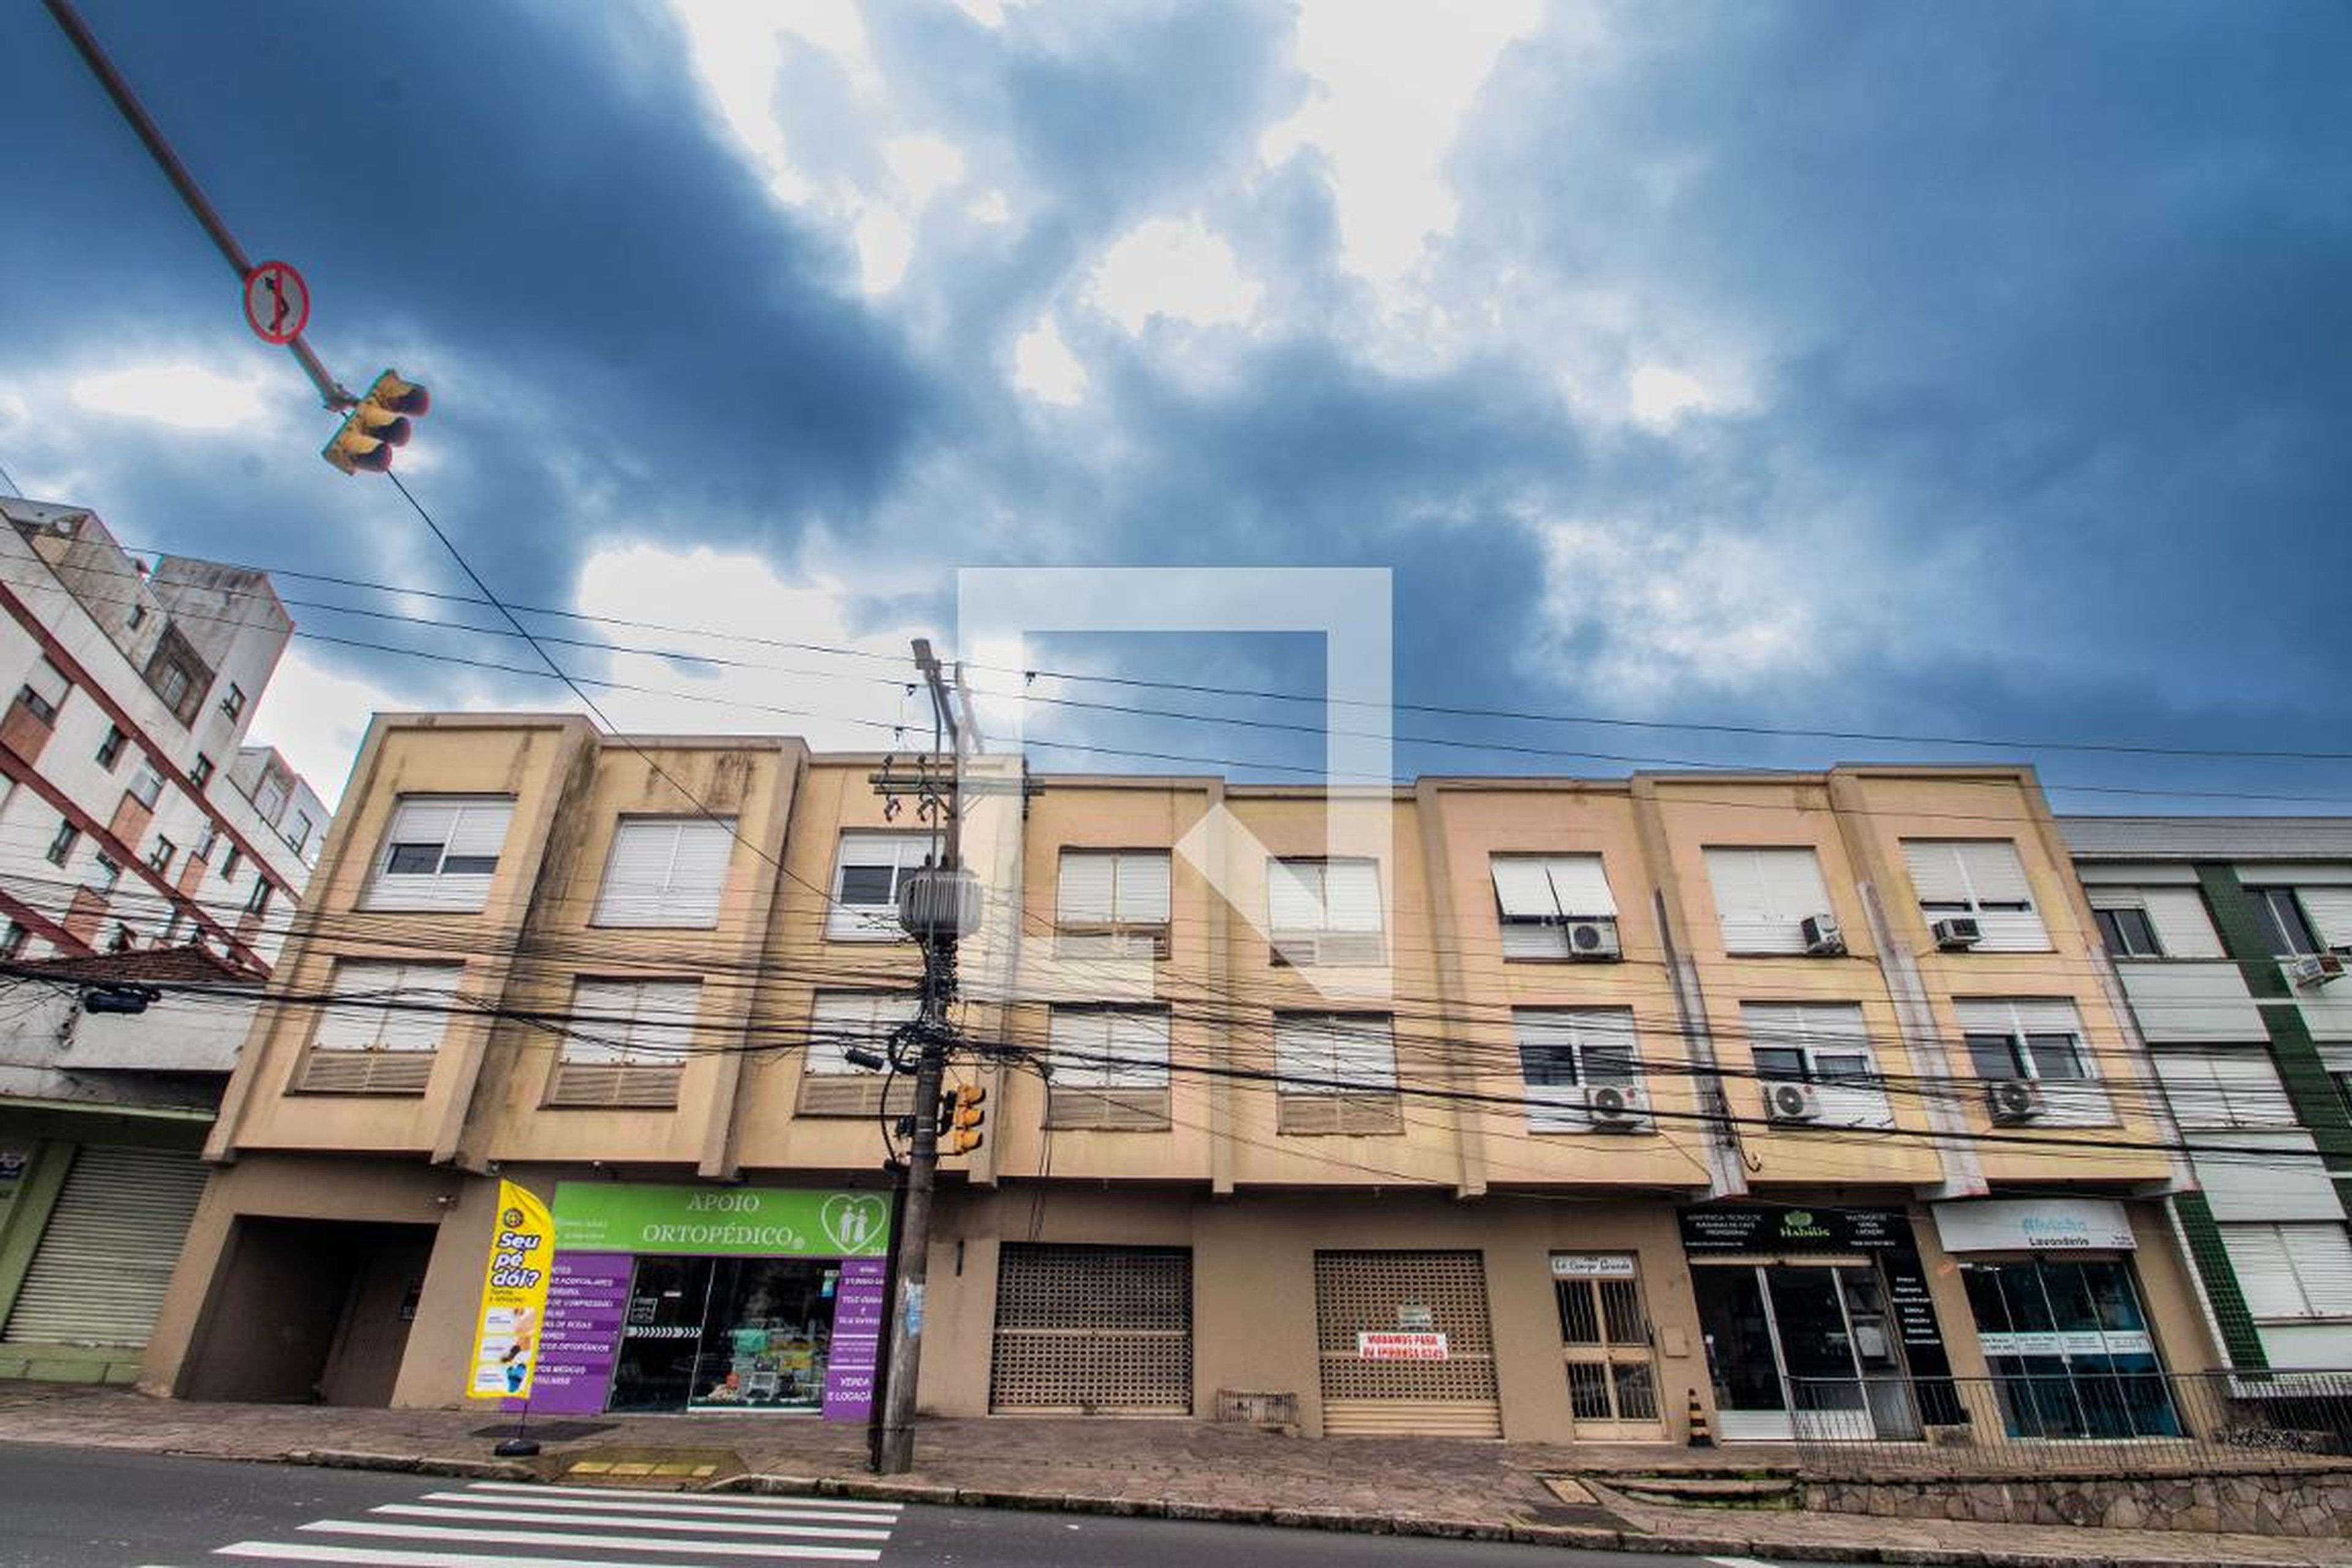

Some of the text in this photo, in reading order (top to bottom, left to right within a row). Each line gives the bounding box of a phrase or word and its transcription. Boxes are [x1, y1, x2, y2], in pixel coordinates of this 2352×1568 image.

[686, 1193, 760, 1212] APOIO
[499, 1231, 541, 1250] Seu
[643, 1223, 793, 1246] ORTOPÉDICO
[493, 1251, 525, 1270] pé
[835, 1390, 872, 1403] LOCAÇÃ
